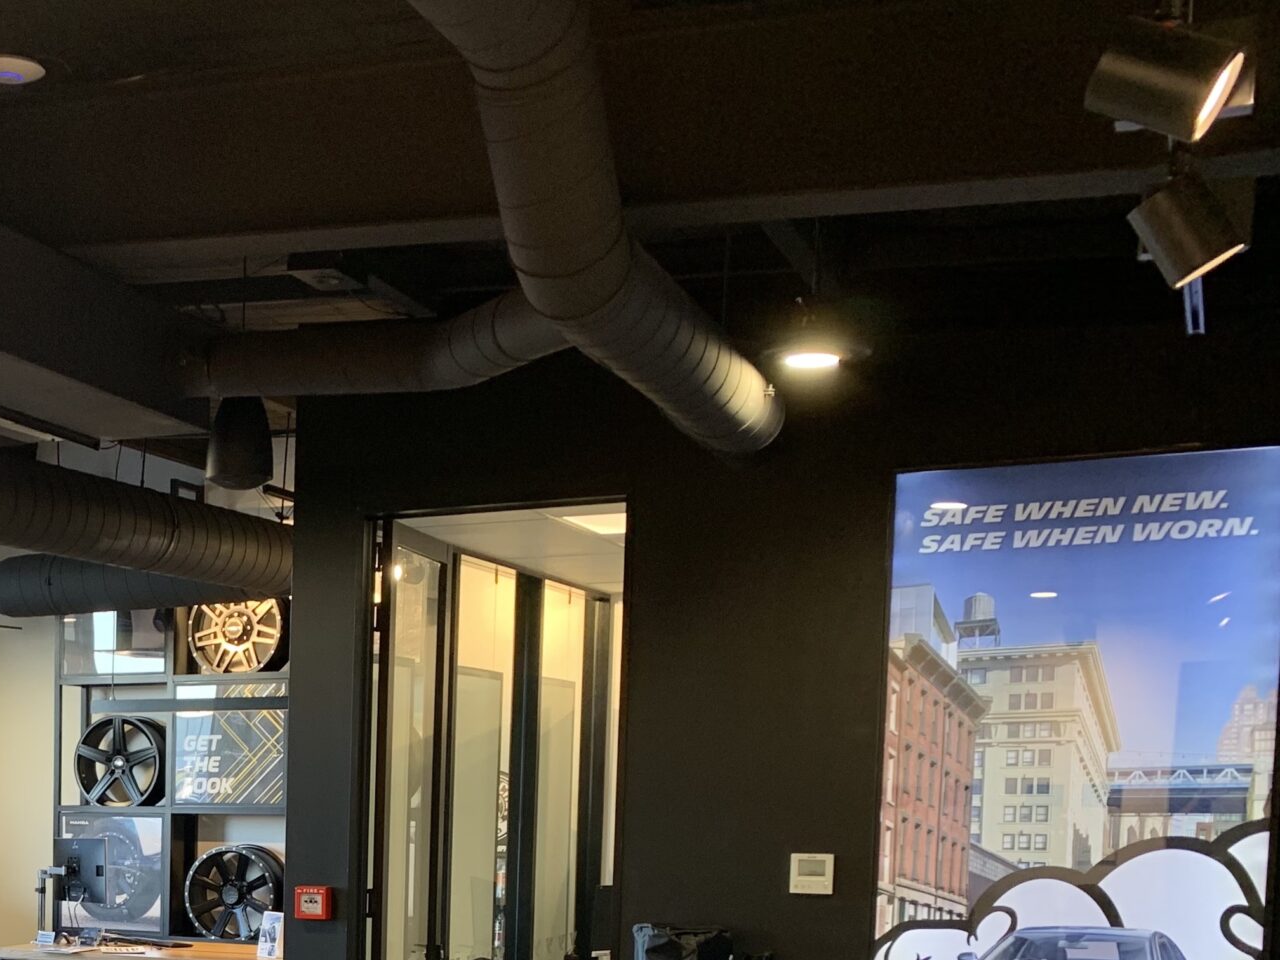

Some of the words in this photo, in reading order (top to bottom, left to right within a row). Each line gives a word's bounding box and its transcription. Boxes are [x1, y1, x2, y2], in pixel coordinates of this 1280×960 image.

[920, 503, 1008, 527] SAFE
[1014, 496, 1127, 522] WHEN
[1131, 489, 1229, 514] NEW.
[919, 531, 1006, 554] SAFE
[1013, 524, 1125, 549] WHEN
[1132, 516, 1259, 542] WORN.
[183, 734, 222, 752] GET
[183, 756, 221, 773] THE
